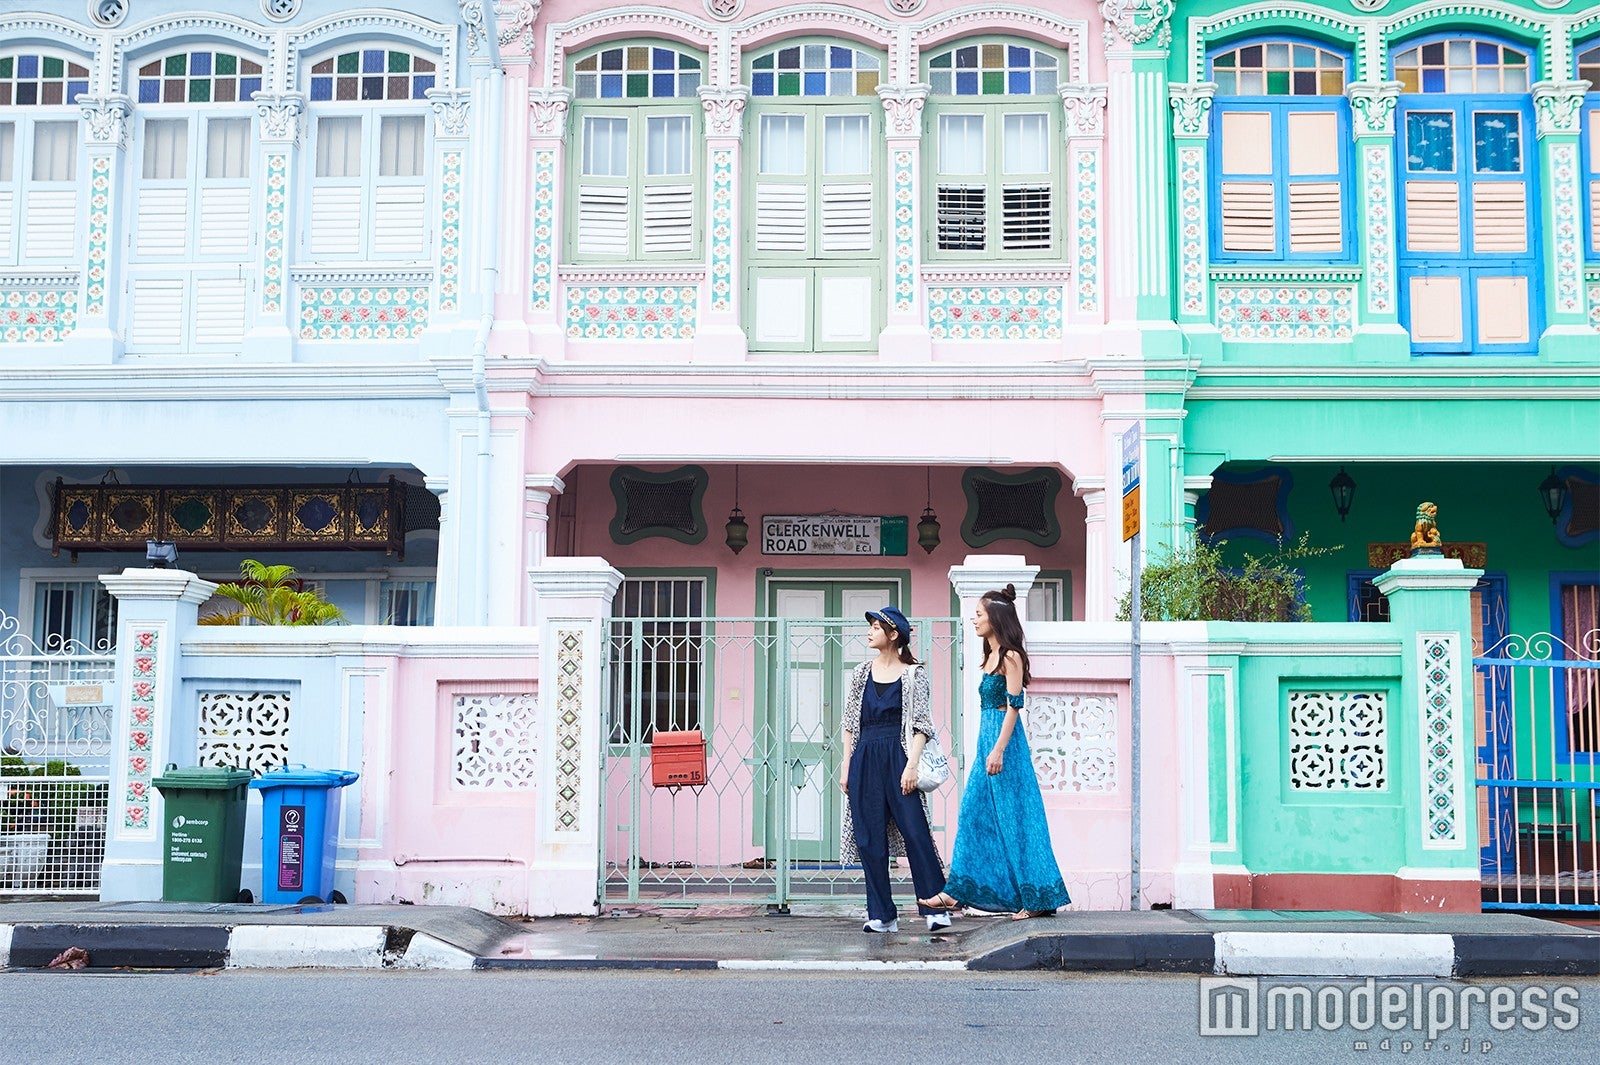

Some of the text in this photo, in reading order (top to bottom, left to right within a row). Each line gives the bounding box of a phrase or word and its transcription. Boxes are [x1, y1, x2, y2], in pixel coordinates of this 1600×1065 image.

[767, 524, 870, 537] CLERKENWELL
[766, 539, 807, 551] ROAD
[691, 771, 701, 780] 15
